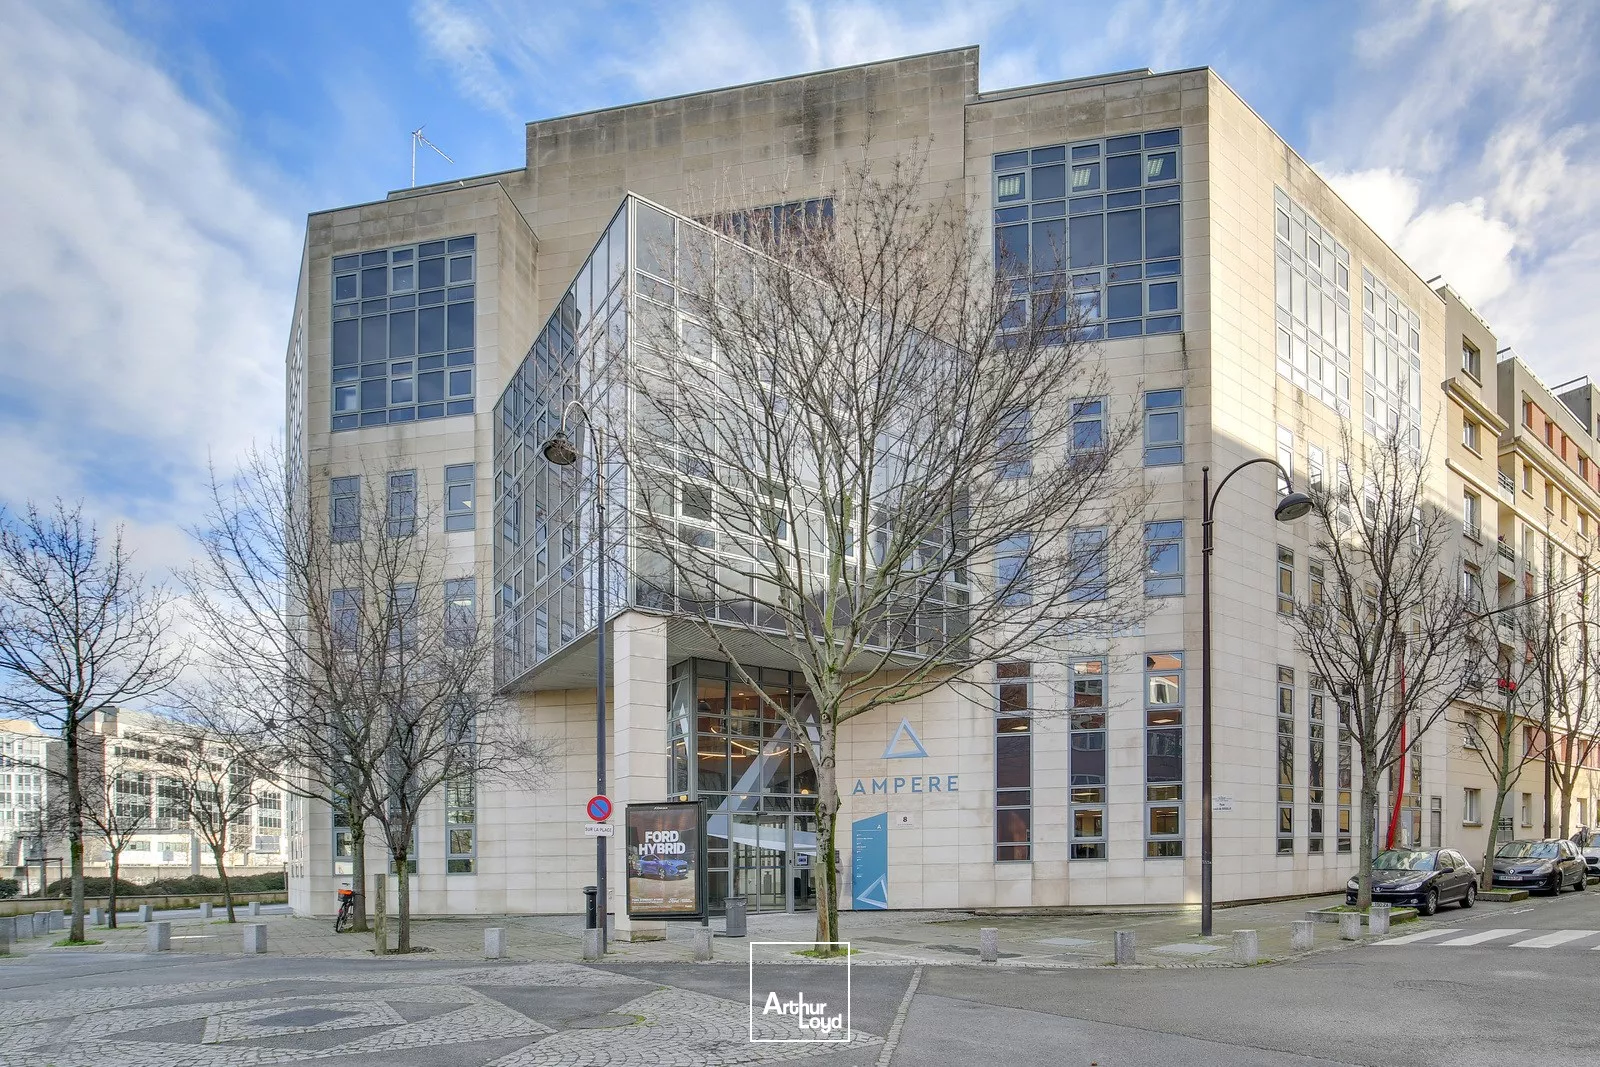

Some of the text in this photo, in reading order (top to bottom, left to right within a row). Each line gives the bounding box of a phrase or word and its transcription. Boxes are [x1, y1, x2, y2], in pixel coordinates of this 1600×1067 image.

[853, 775, 959, 795] AMPERE
[645, 830, 679, 842] FORD
[639, 842, 685, 855] HYBRID
